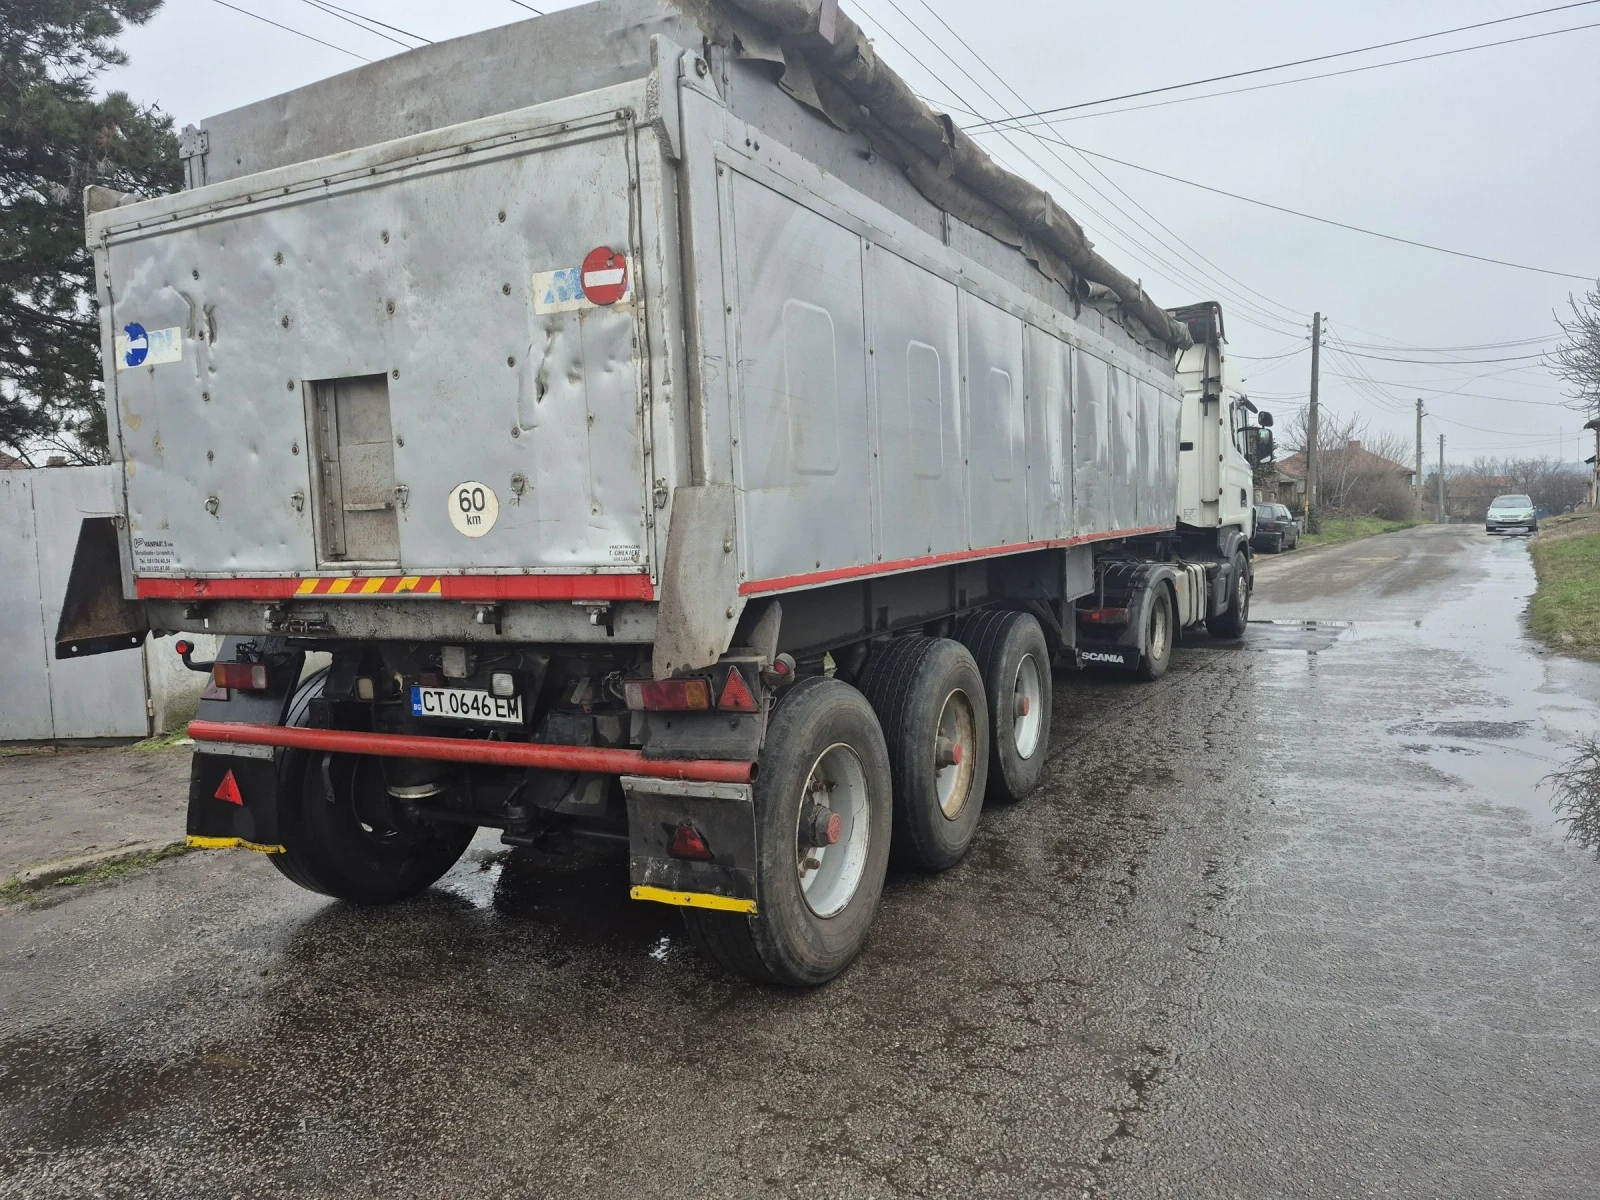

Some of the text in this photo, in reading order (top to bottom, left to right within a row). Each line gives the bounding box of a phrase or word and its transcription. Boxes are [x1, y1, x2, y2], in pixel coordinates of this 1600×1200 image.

[458, 487, 485, 512] 60
[466, 514, 481, 525] km
[1081, 651, 1125, 664] SCANIA
[413, 703, 422, 711] BG
[423, 690, 445, 713] CT
[449, 692, 492, 717] 0646
